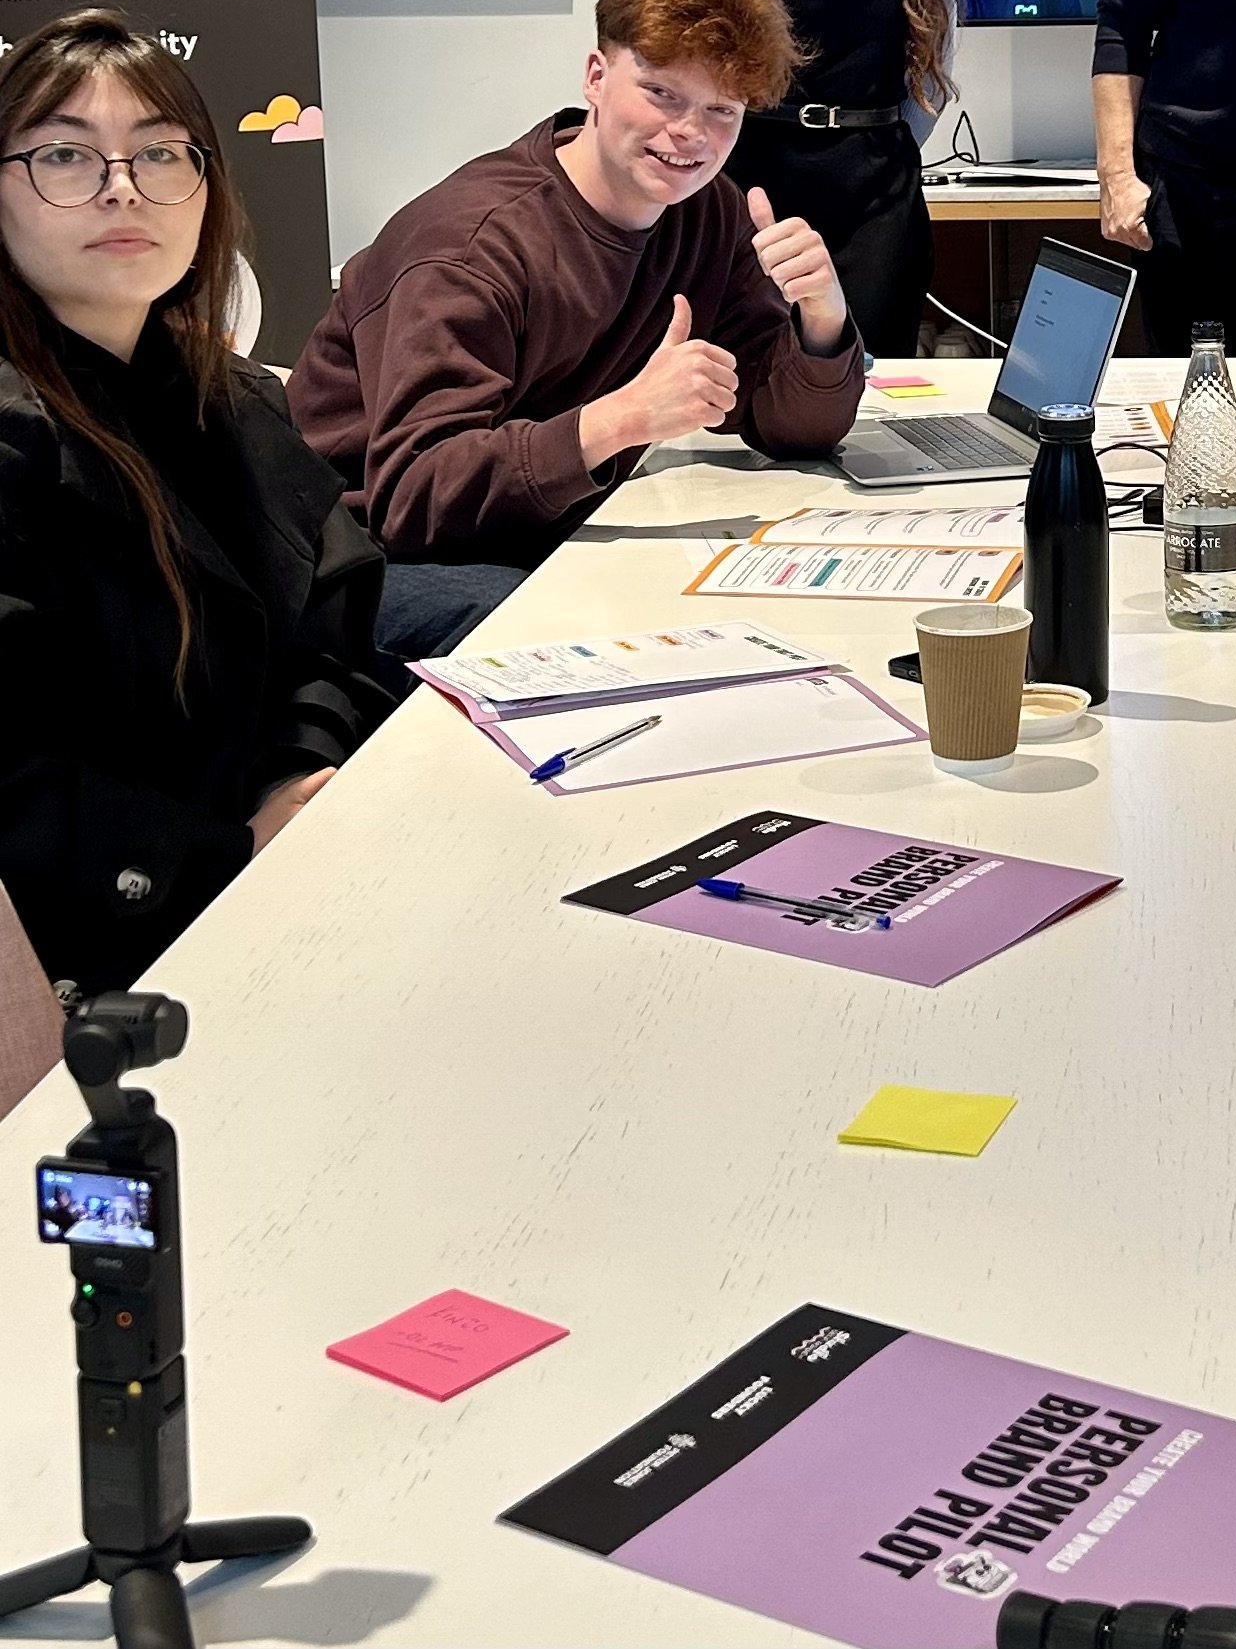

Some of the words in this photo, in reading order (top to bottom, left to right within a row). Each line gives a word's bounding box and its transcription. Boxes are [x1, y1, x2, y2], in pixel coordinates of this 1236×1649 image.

[850, 845, 944, 887] BRAND
[960, 1391, 1102, 1489] BRAND
[1151, 1427, 1204, 1468] CREATE
[964, 1408, 1164, 1555] PERSONAL
[1122, 1465, 1168, 1498] YOUR
[858, 1487, 995, 1580] PILOT
[1086, 1494, 1137, 1536] BRAND
[1046, 1531, 1100, 1574] WORLD
